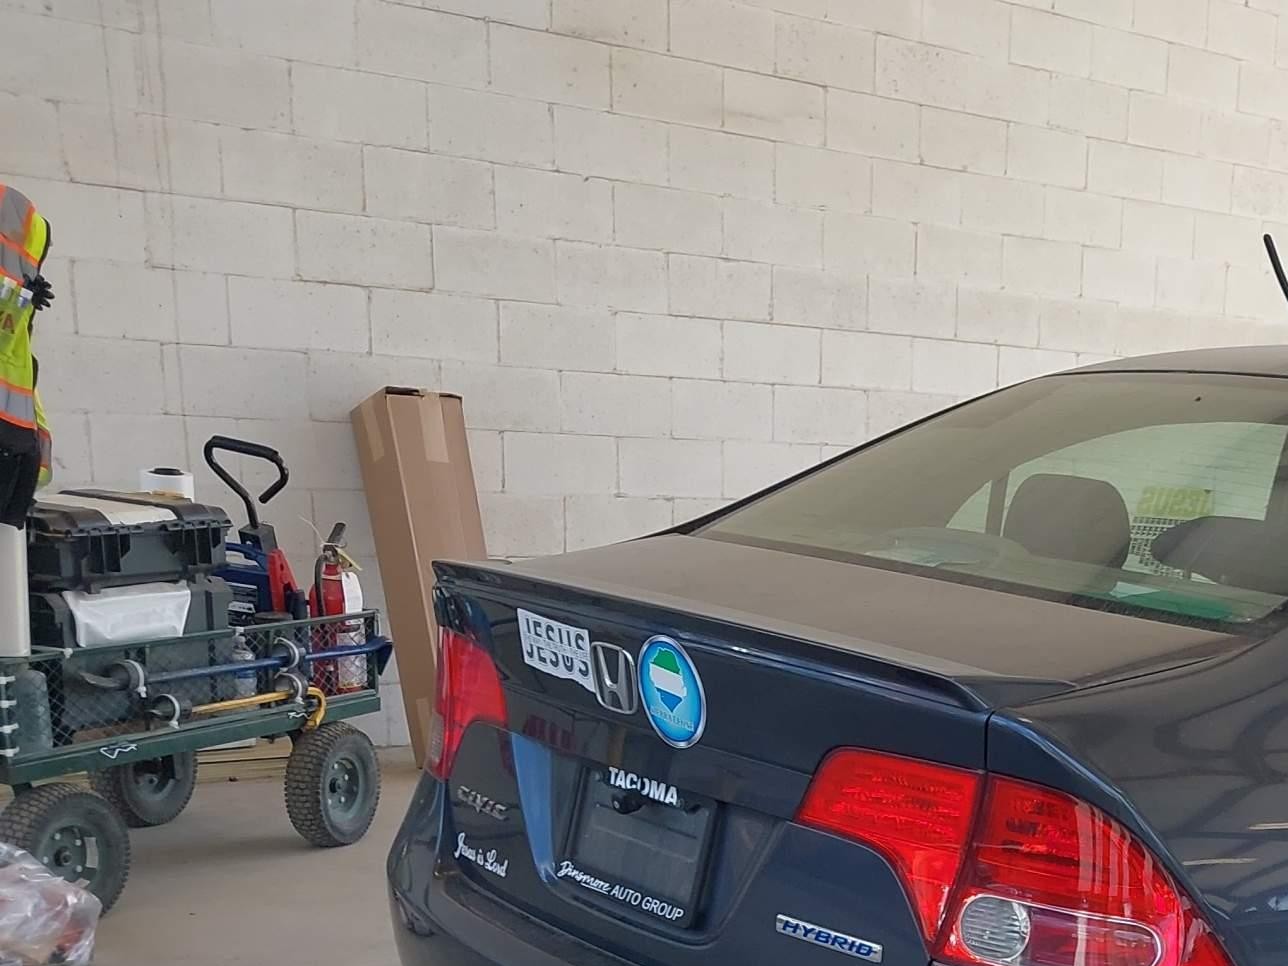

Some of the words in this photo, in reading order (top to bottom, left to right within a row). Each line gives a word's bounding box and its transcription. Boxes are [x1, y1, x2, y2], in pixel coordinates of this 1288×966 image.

[608, 766, 678, 806] TACOMA
[454, 832, 477, 861] Jesus
[477, 849, 484, 866] is
[485, 849, 509, 877] Lord
[610, 885, 642, 906] AUTO
[642, 896, 684, 921] GROUP
[782, 920, 879, 957] HYBRID
